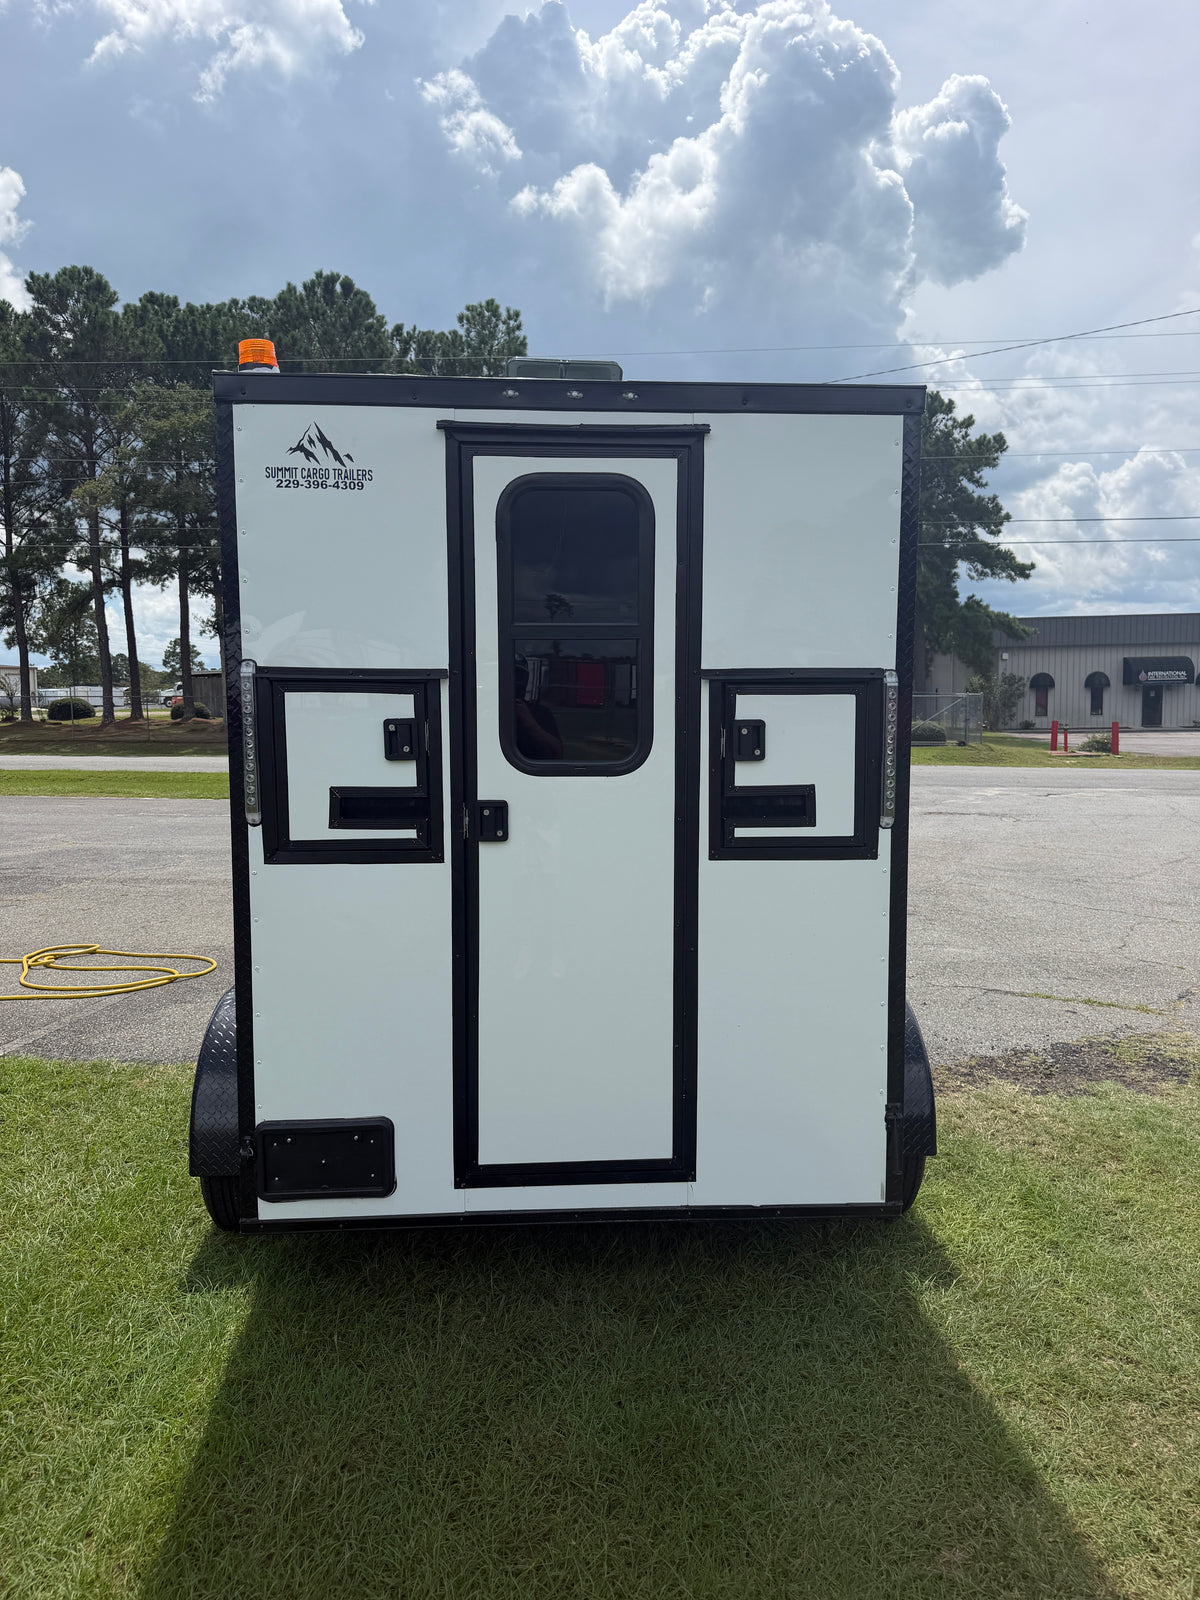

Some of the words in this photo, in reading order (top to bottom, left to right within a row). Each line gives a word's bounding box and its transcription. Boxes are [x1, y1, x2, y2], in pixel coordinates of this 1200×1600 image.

[265, 466, 299, 479] SUMMIT
[300, 467, 330, 480] CARGO
[332, 468, 373, 481] TRAILERS
[275, 479, 365, 491] 229-396-4309
